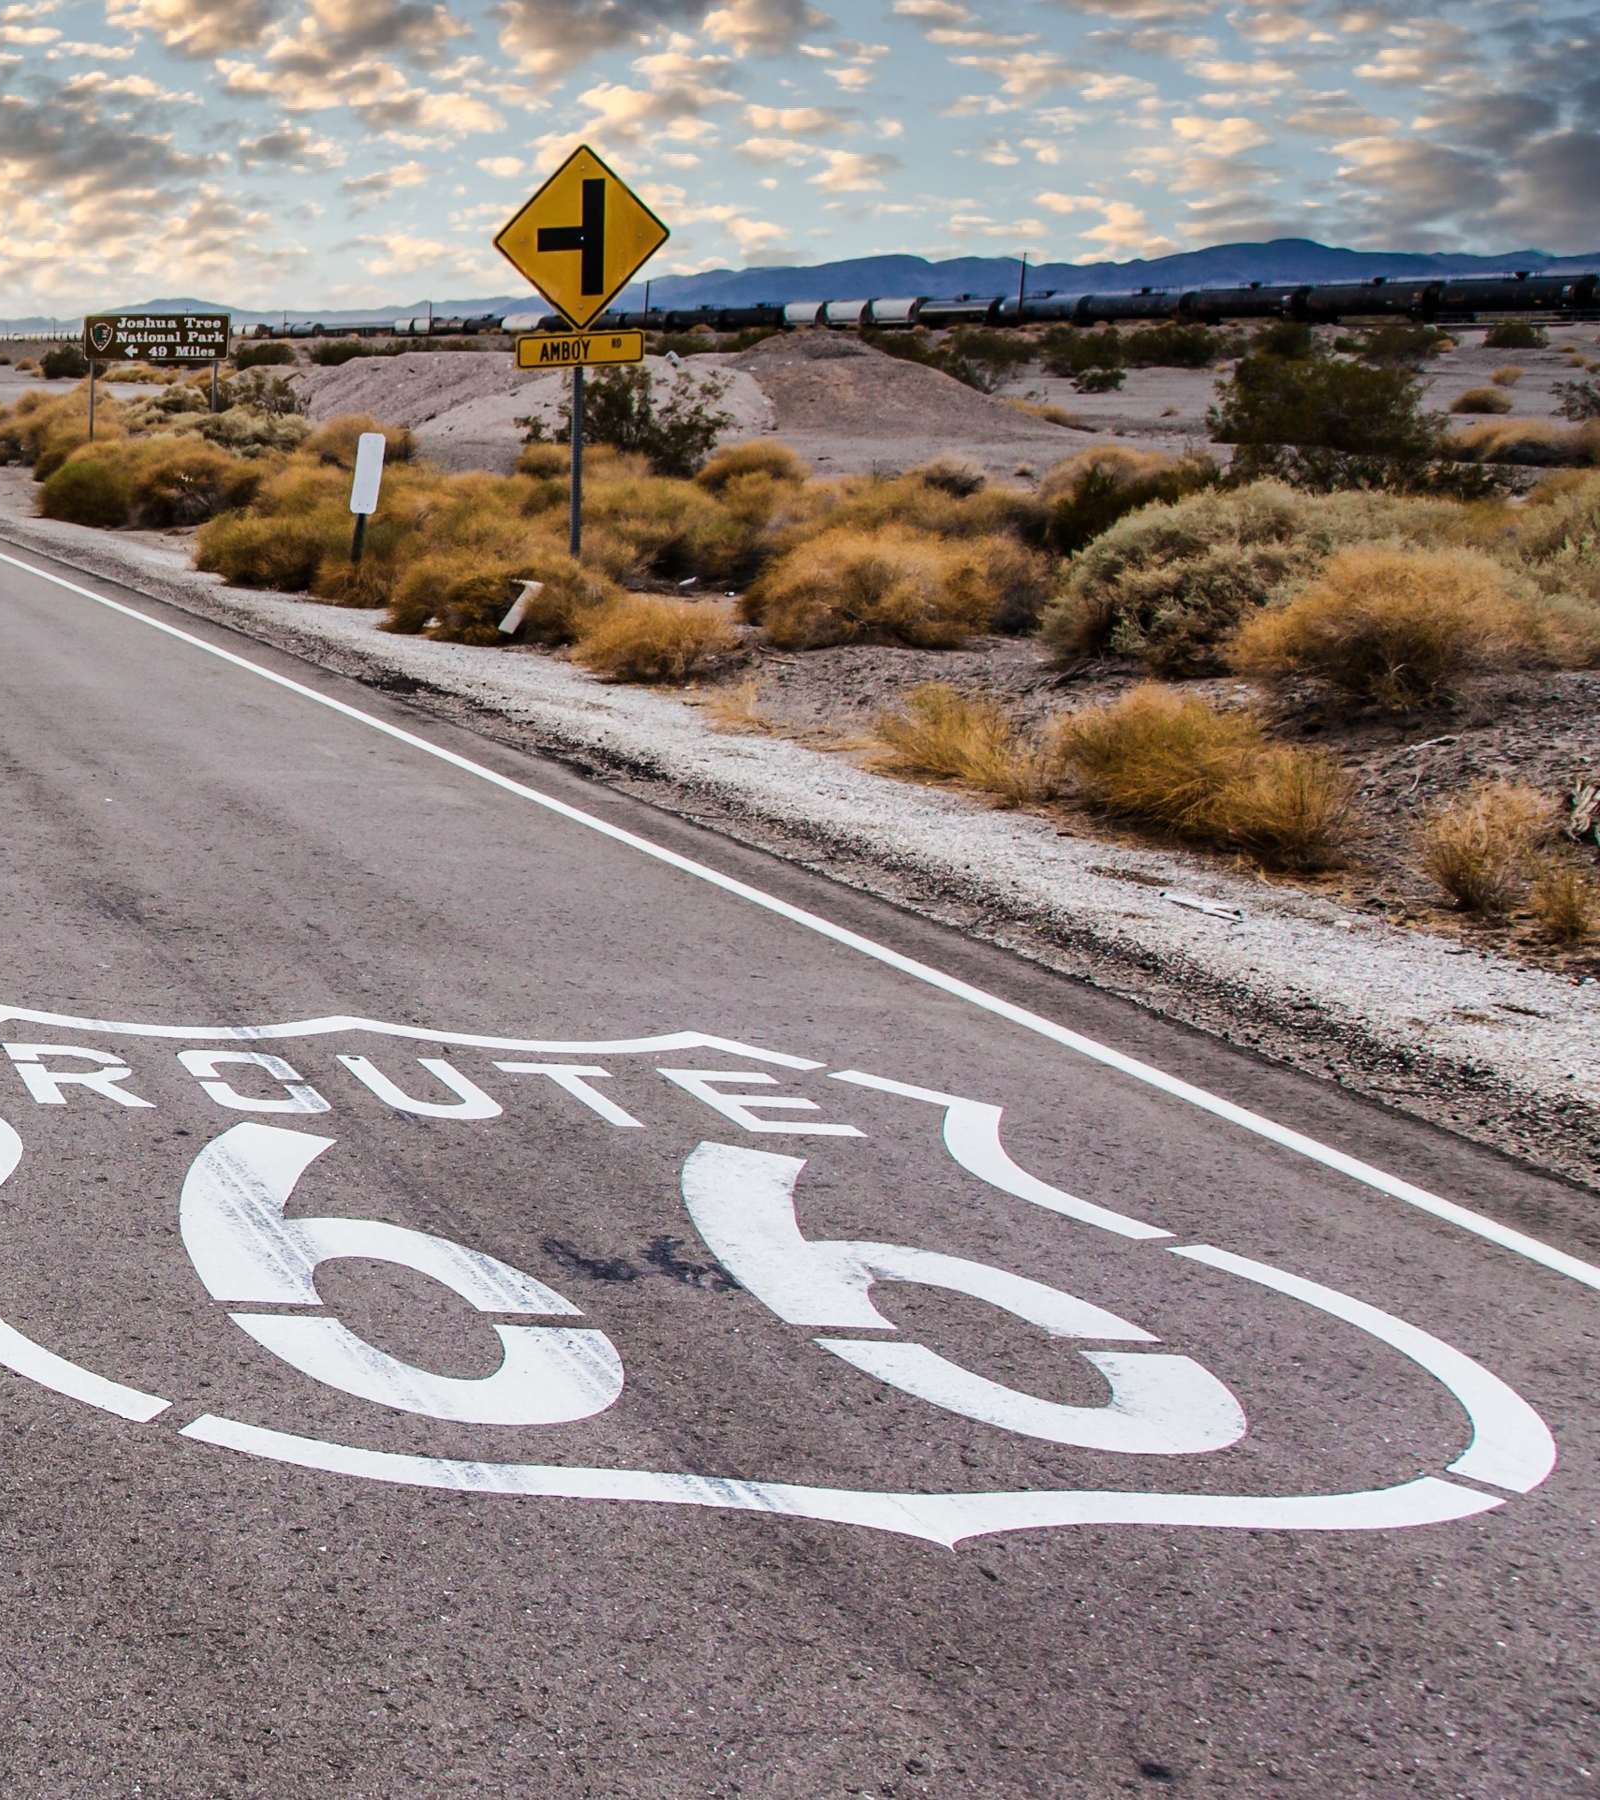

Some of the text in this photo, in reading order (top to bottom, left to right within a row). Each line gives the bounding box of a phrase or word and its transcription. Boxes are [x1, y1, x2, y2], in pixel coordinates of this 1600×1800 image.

[117, 317, 221, 329] Joshua Tree
[116, 331, 181, 343] National
[187, 331, 224, 343] Park
[148, 346, 215, 357] 49 Miles
[540, 338, 622, 362] AMBOY RD
[2, 1042, 868, 1137] ROUTE
[179, 1121, 1247, 1455] 66
